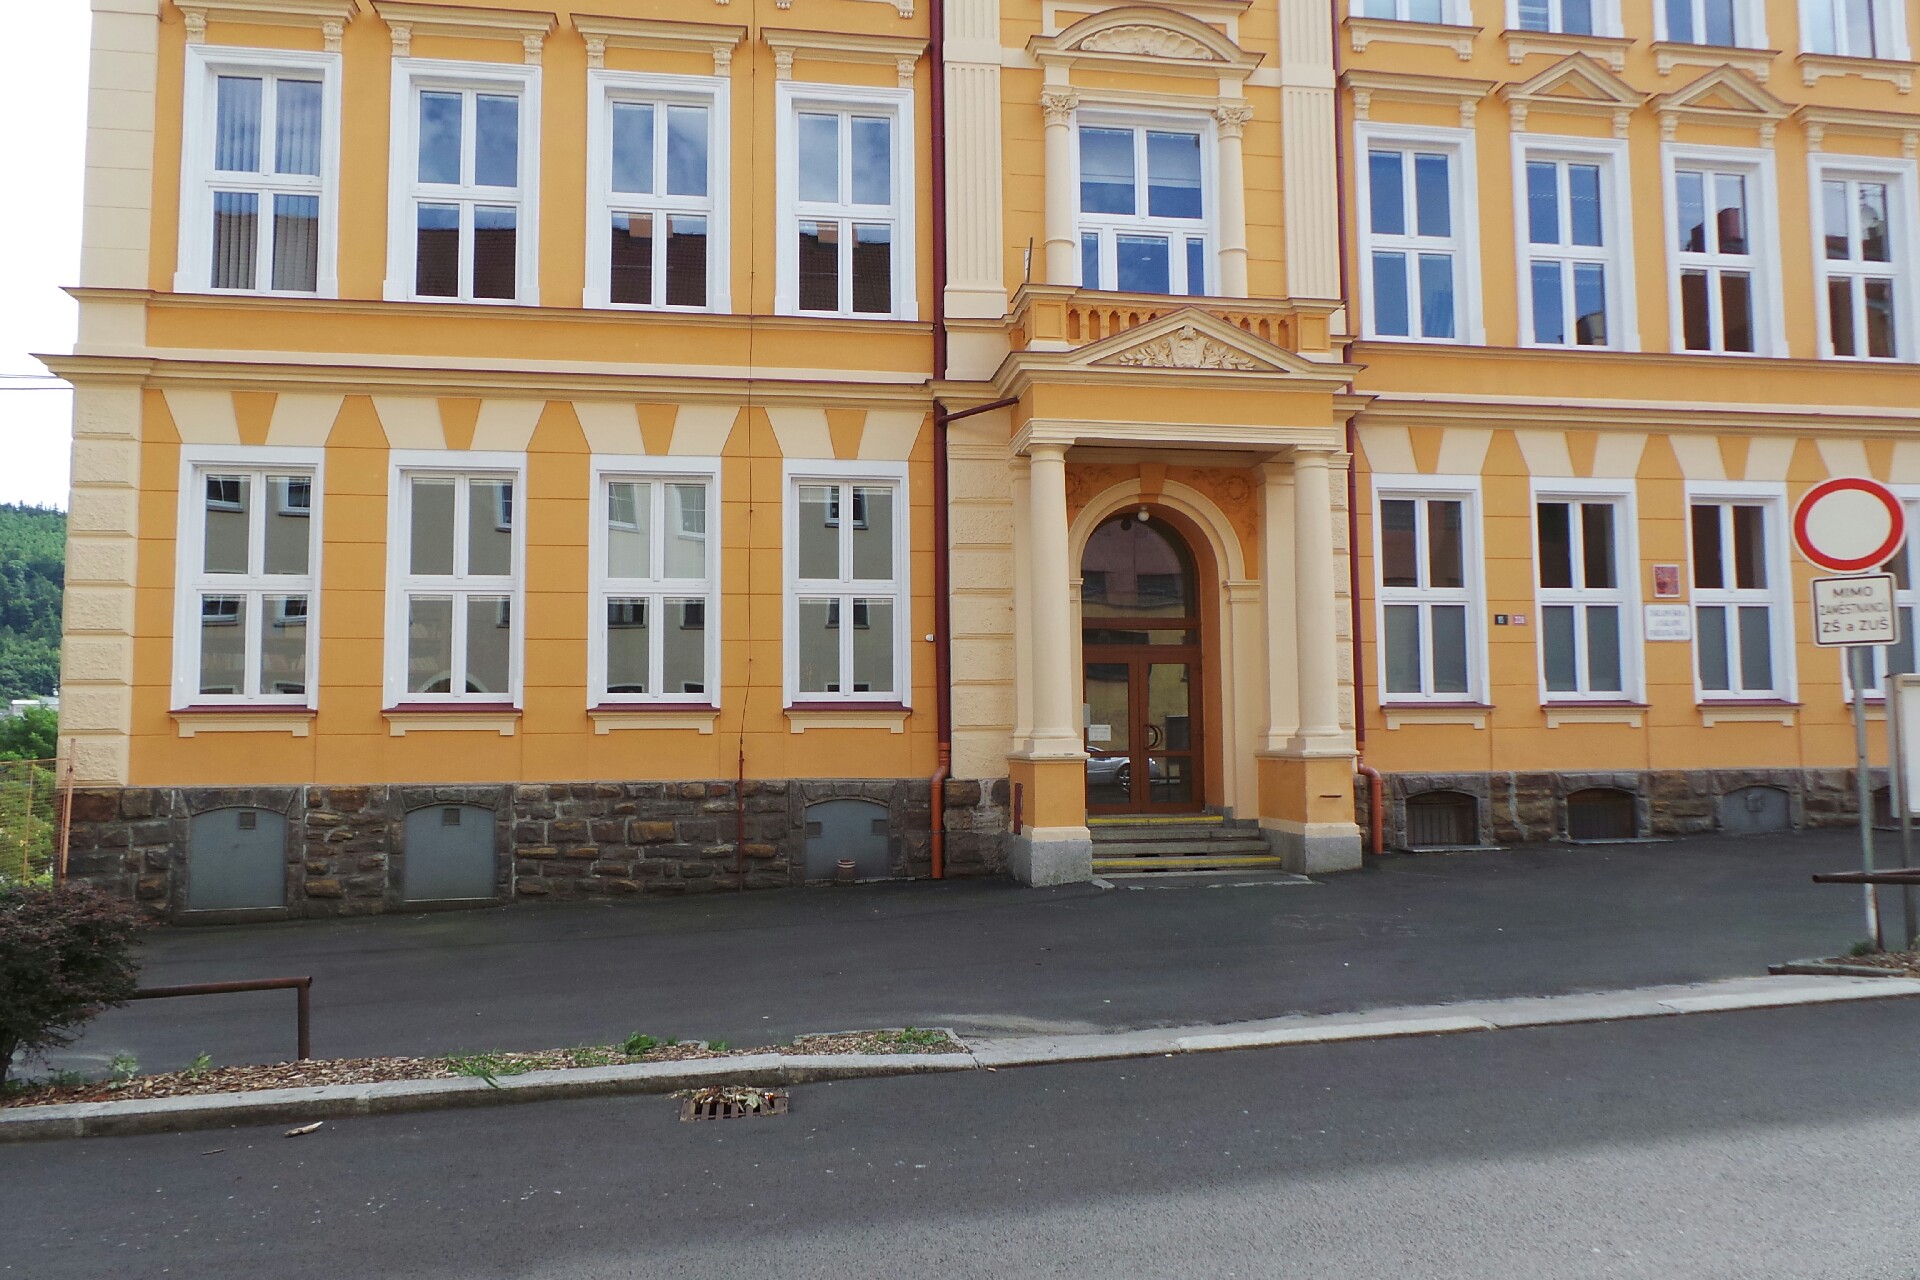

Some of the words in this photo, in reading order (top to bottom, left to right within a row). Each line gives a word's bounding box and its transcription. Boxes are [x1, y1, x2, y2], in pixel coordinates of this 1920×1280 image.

[1832, 586, 1873, 598] MIMO
[1822, 619, 1841, 633] ZŠ
[1846, 623, 1855, 632] a
[1859, 616, 1889, 631] ZUŠ
